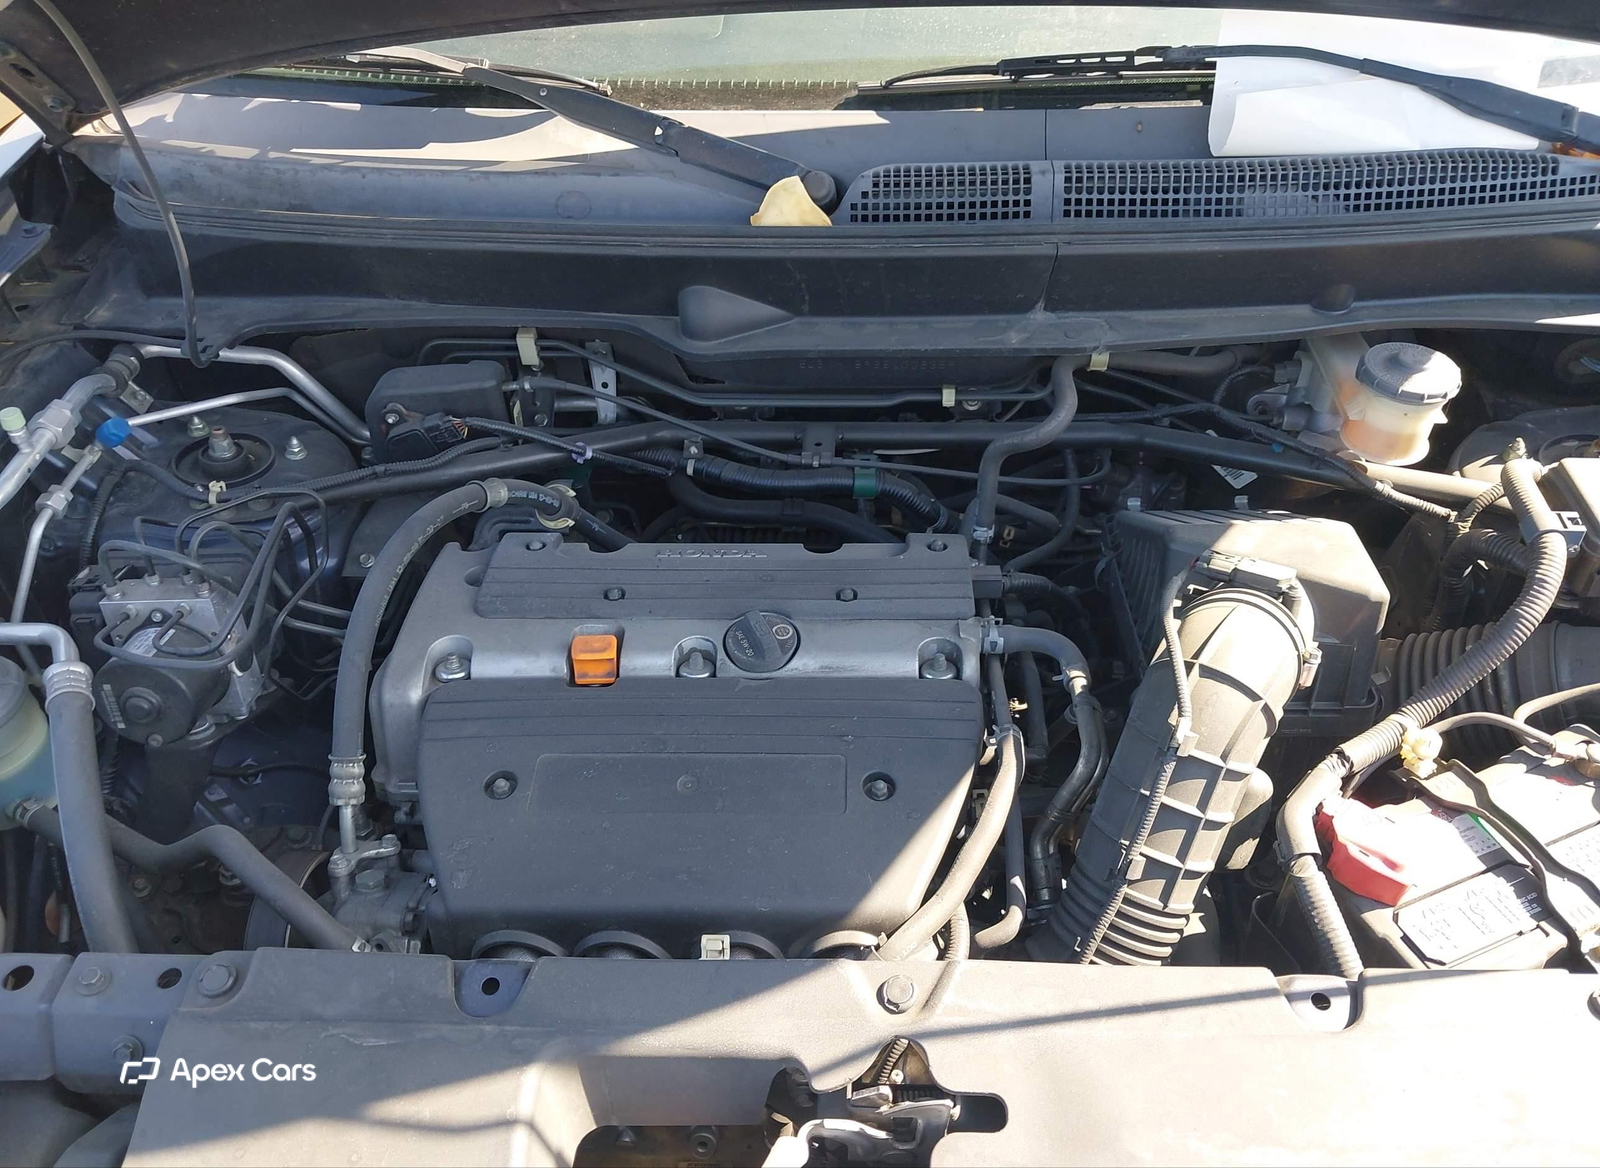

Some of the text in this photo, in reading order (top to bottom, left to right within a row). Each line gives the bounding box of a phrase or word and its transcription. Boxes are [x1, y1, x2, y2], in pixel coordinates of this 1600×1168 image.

[656, 547, 767, 559] HONDA
[735, 630, 746, 641] SAE
[740, 638, 755, 658] 5W-20
